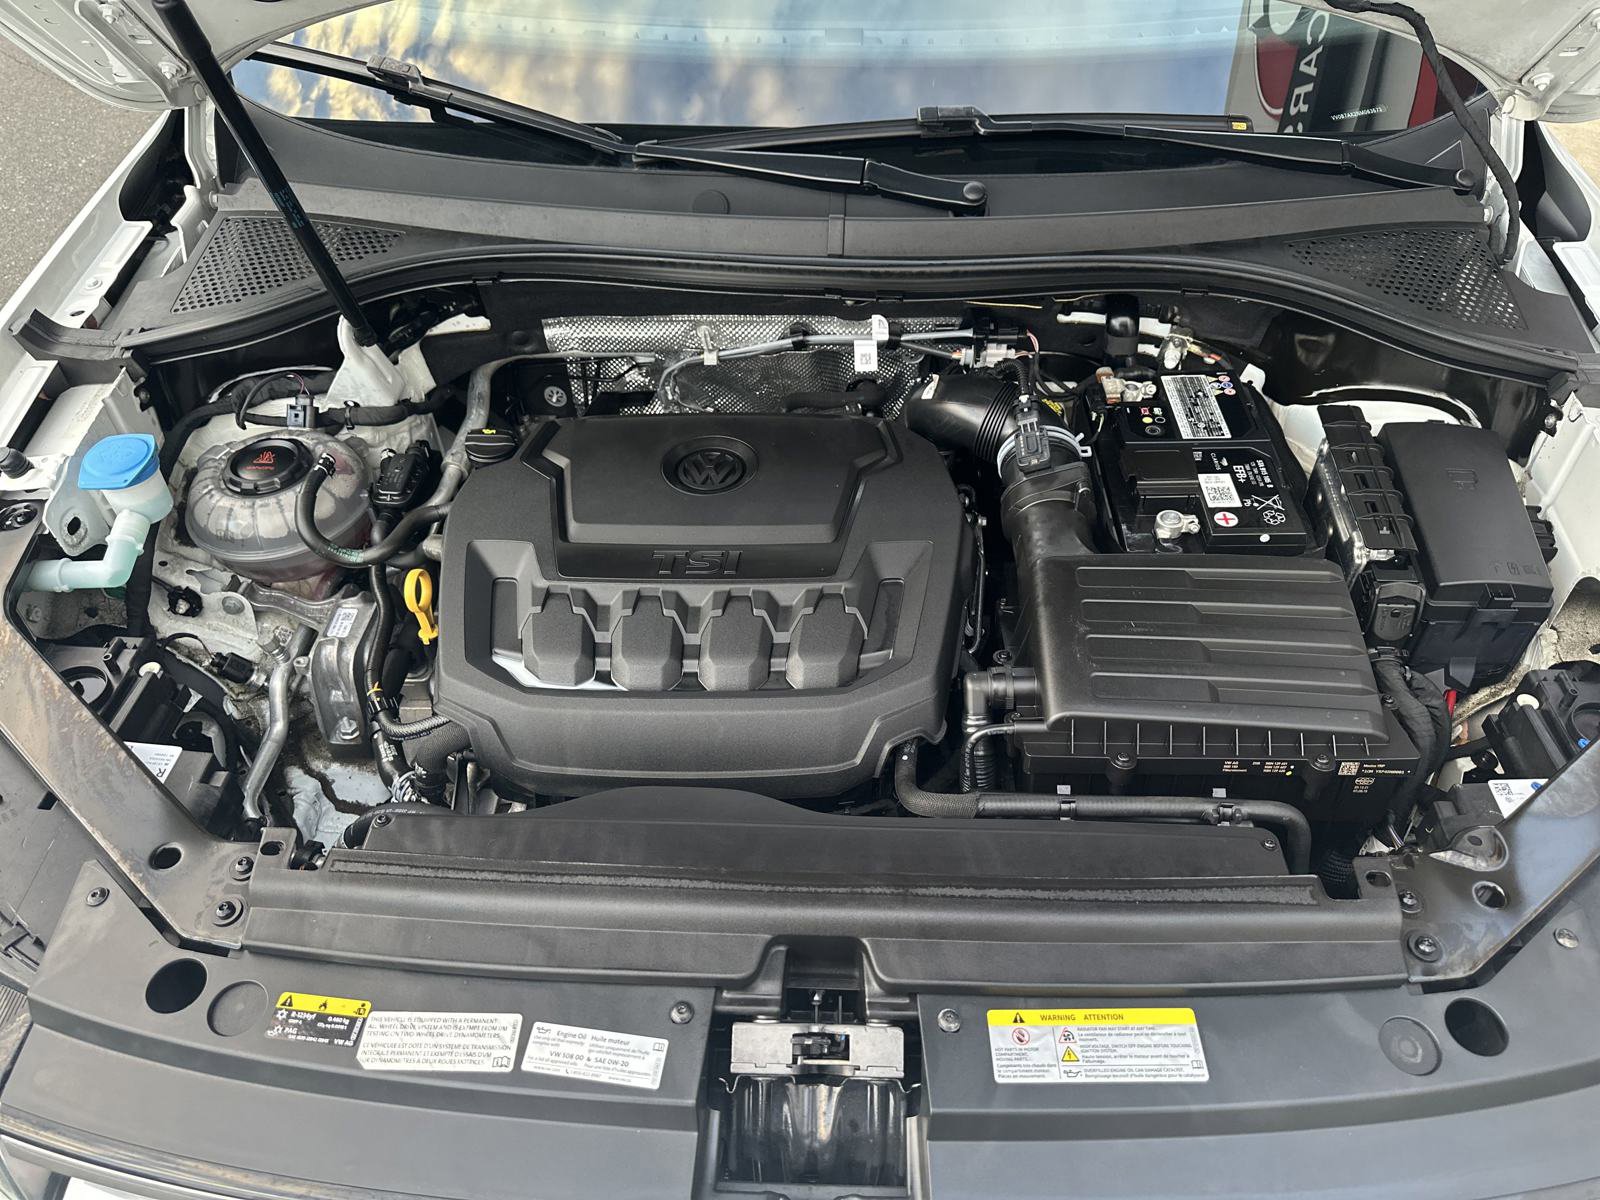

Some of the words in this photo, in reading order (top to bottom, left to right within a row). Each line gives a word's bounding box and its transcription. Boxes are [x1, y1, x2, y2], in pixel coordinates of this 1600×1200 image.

[1232, 465, 1247, 484] EFB+
[653, 550, 744, 575] TSI
[156, 768, 166, 778] R
[557, 1030, 577, 1039] Engine
[607, 1059, 630, 1067] 0W-20
